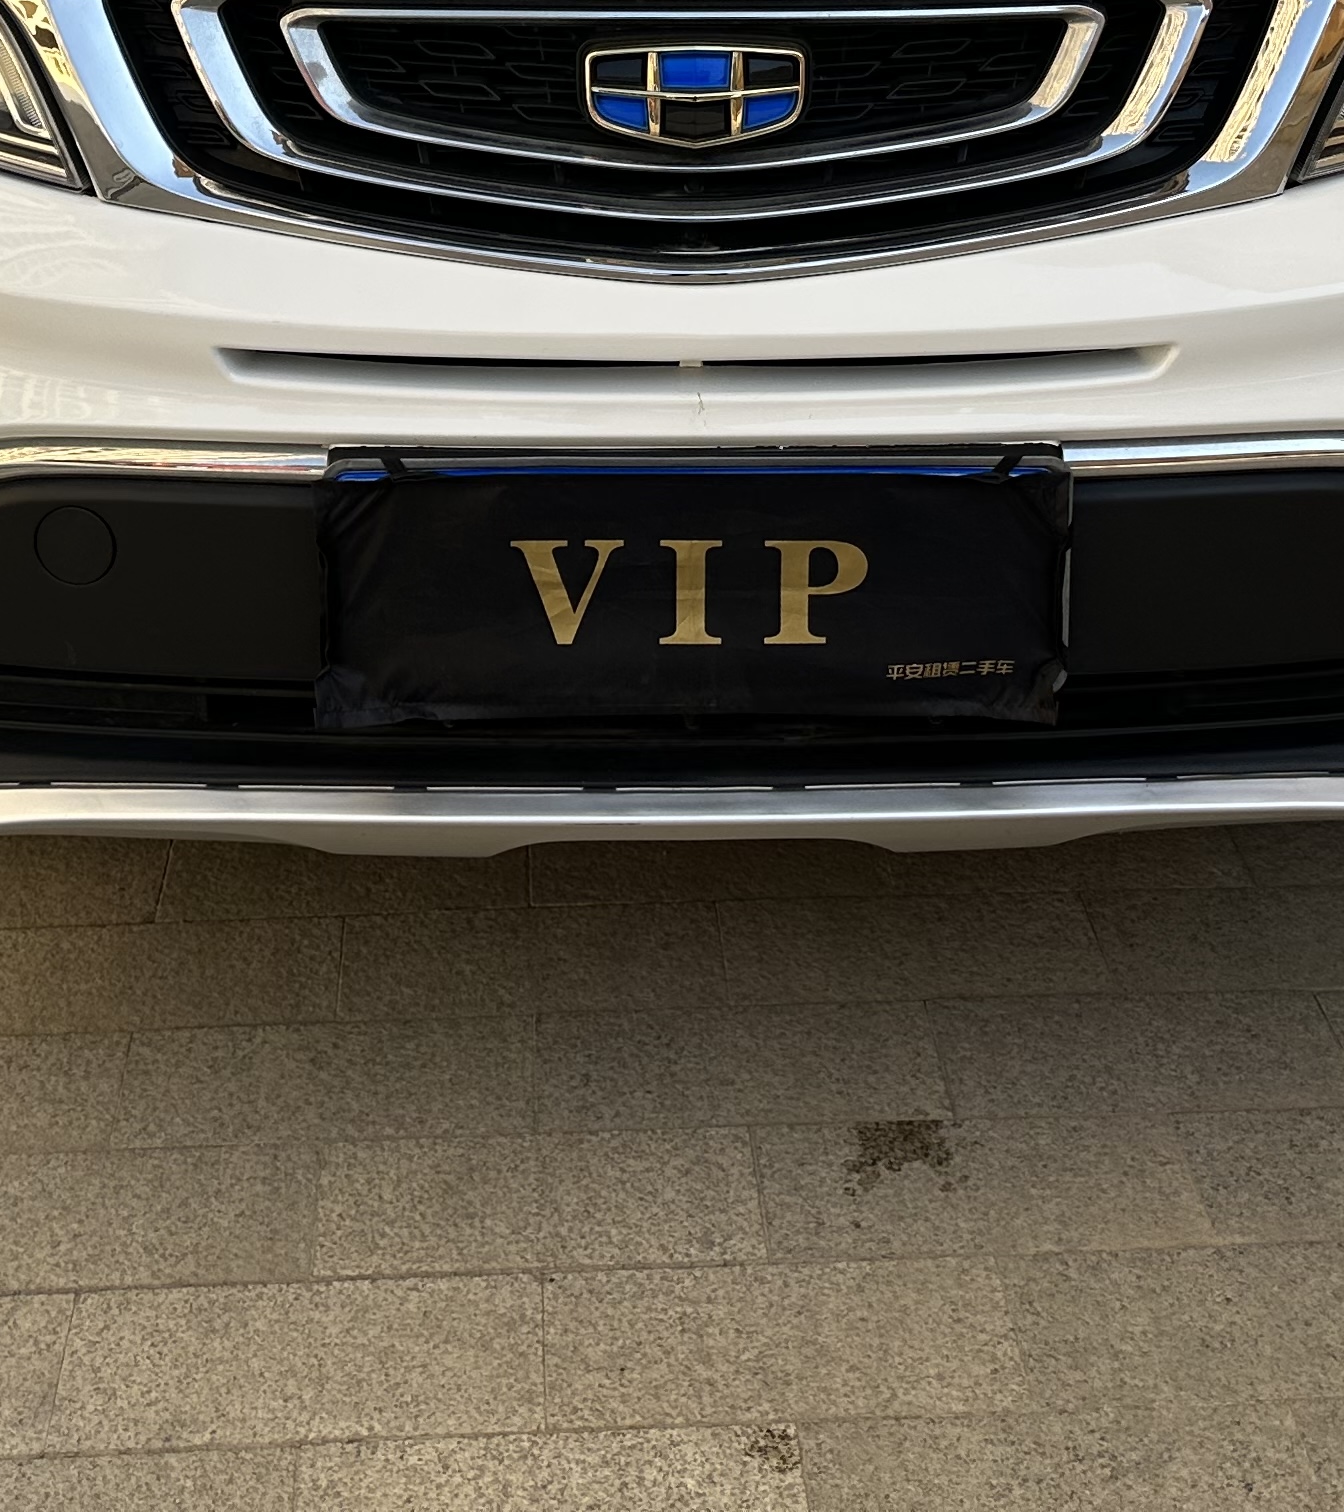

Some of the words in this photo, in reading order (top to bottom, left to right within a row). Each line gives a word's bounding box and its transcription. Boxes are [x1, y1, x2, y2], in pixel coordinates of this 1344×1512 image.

[510, 540, 869, 645] VIP
[886, 660, 1015, 680] 平安租赁二手车
